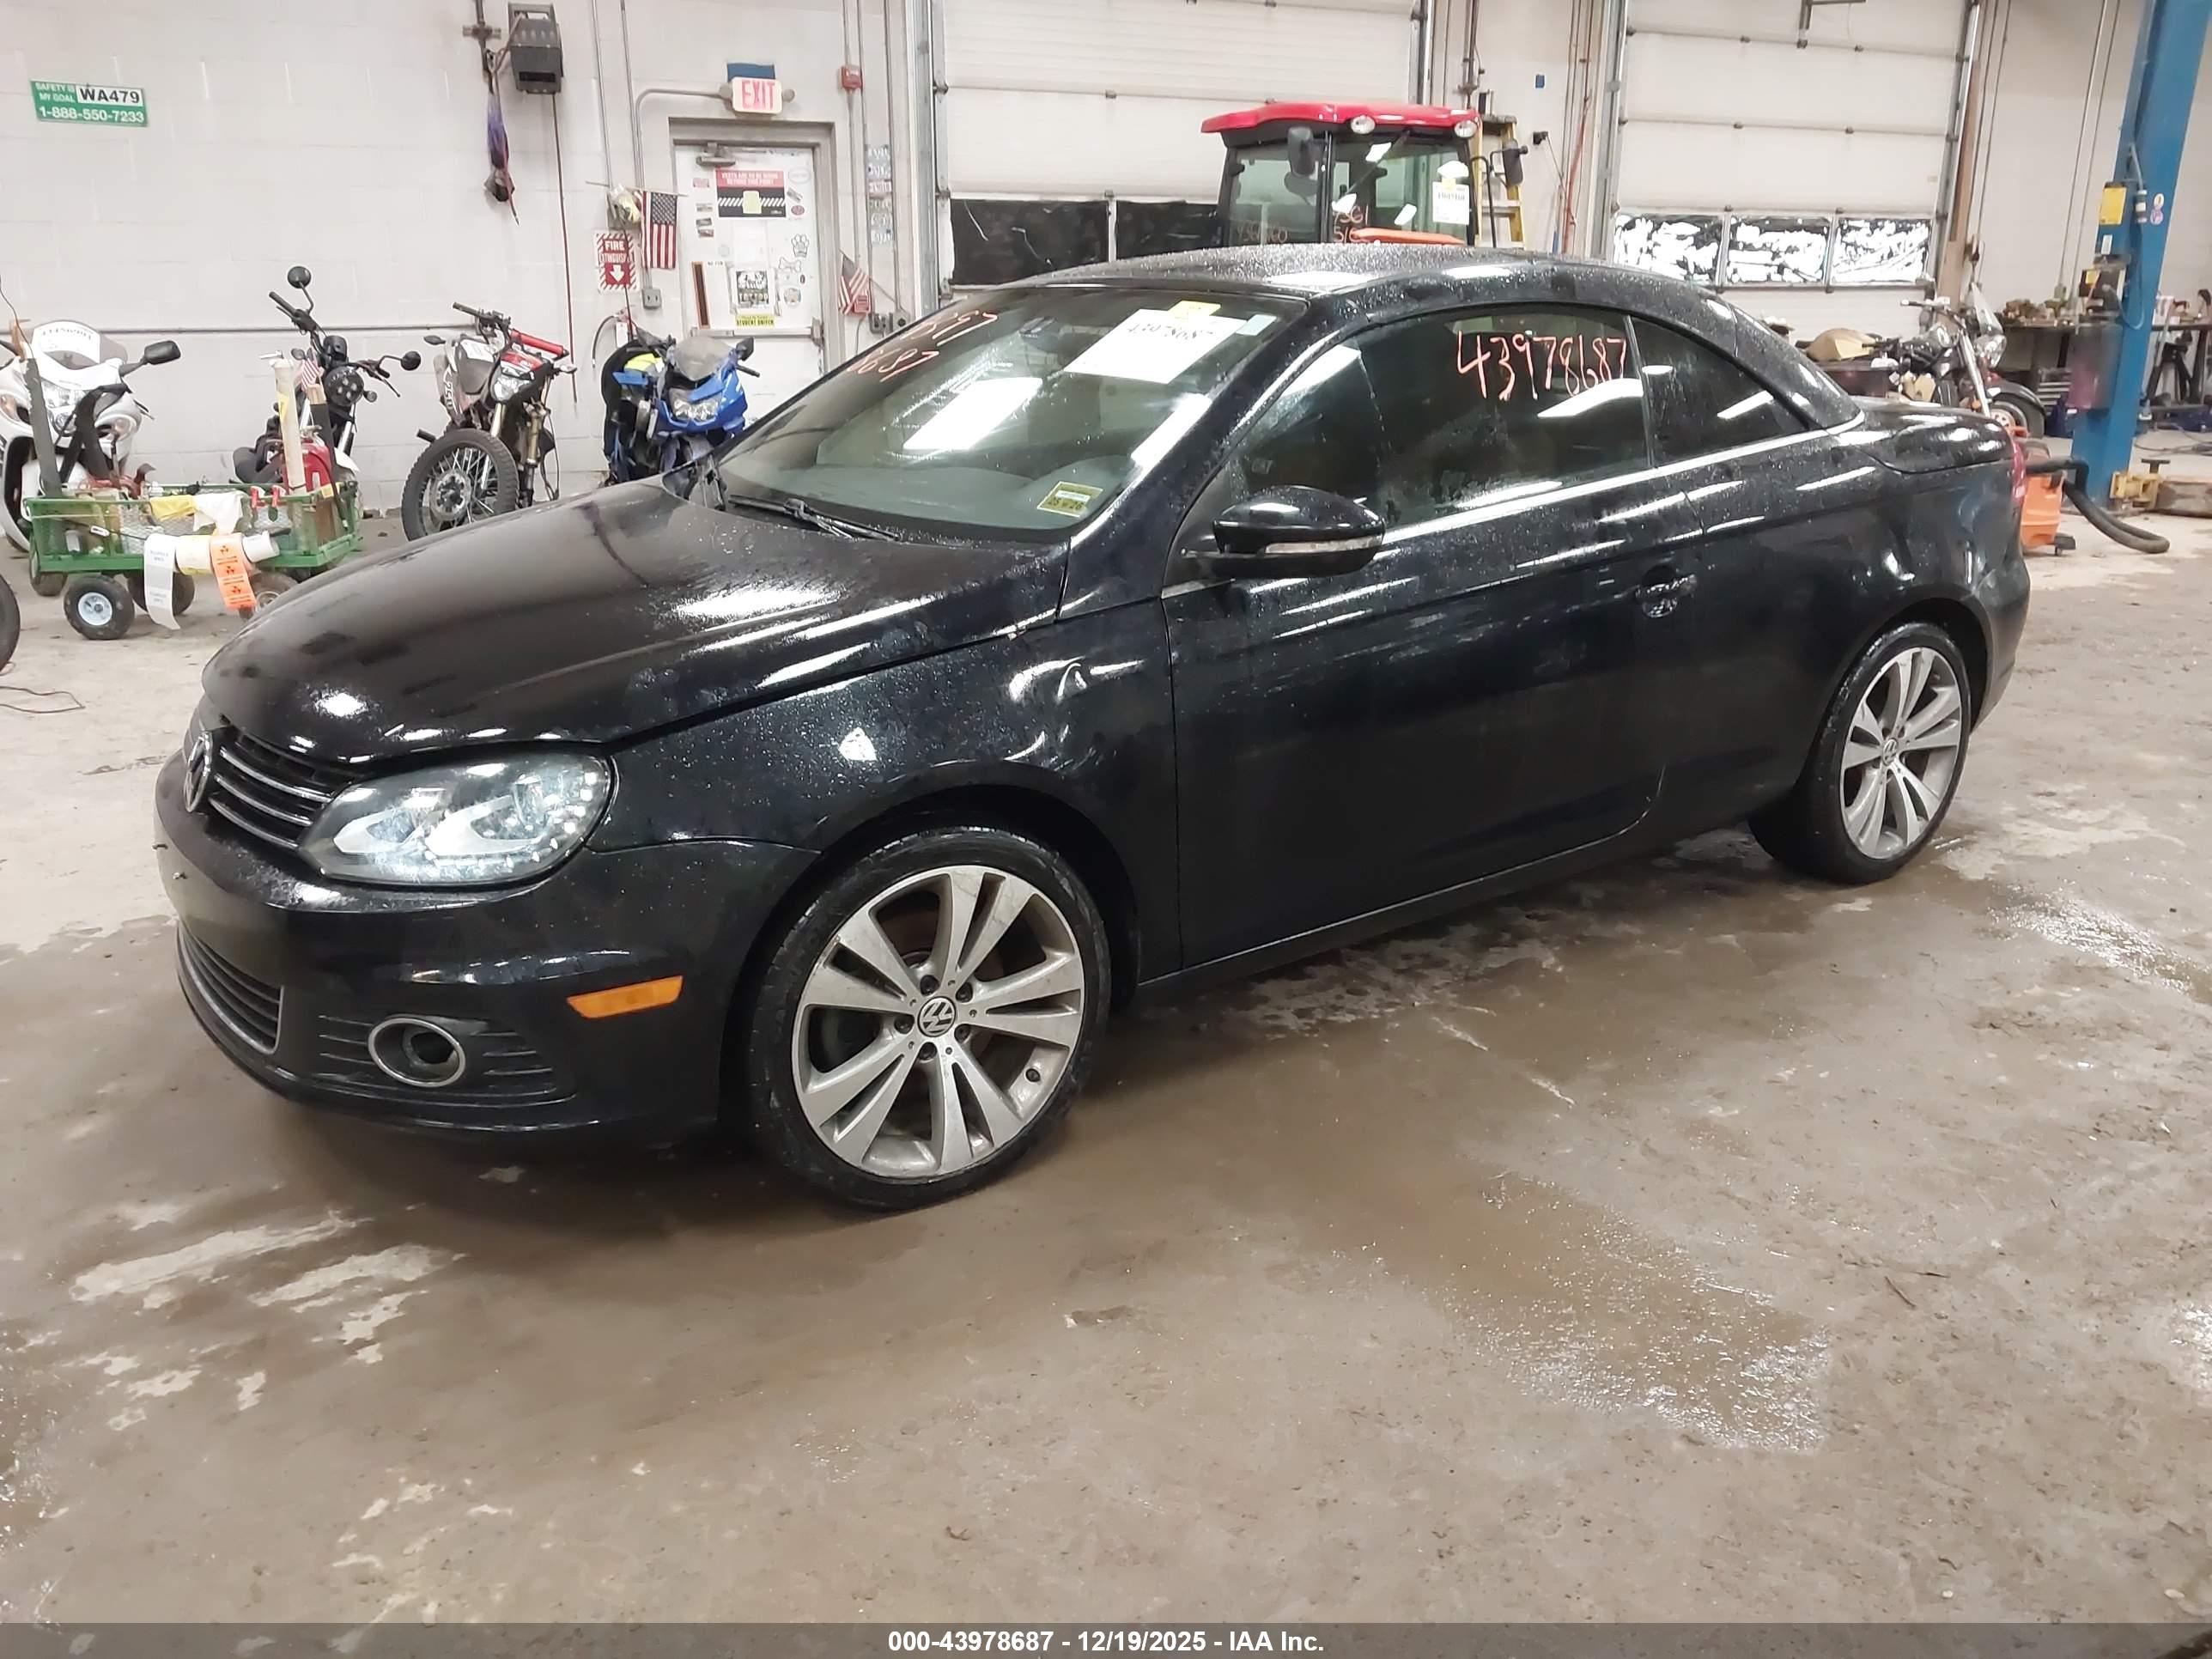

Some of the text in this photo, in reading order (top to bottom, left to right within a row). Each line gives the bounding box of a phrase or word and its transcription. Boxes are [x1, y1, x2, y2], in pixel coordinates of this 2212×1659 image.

[79, 88, 140, 104] WA479
[741, 80, 775, 110] EXIT
[39, 106, 144, 123] 1-888-550-7233
[605, 240, 625, 252] FIRE
[1456, 331, 1627, 401] 43978687
